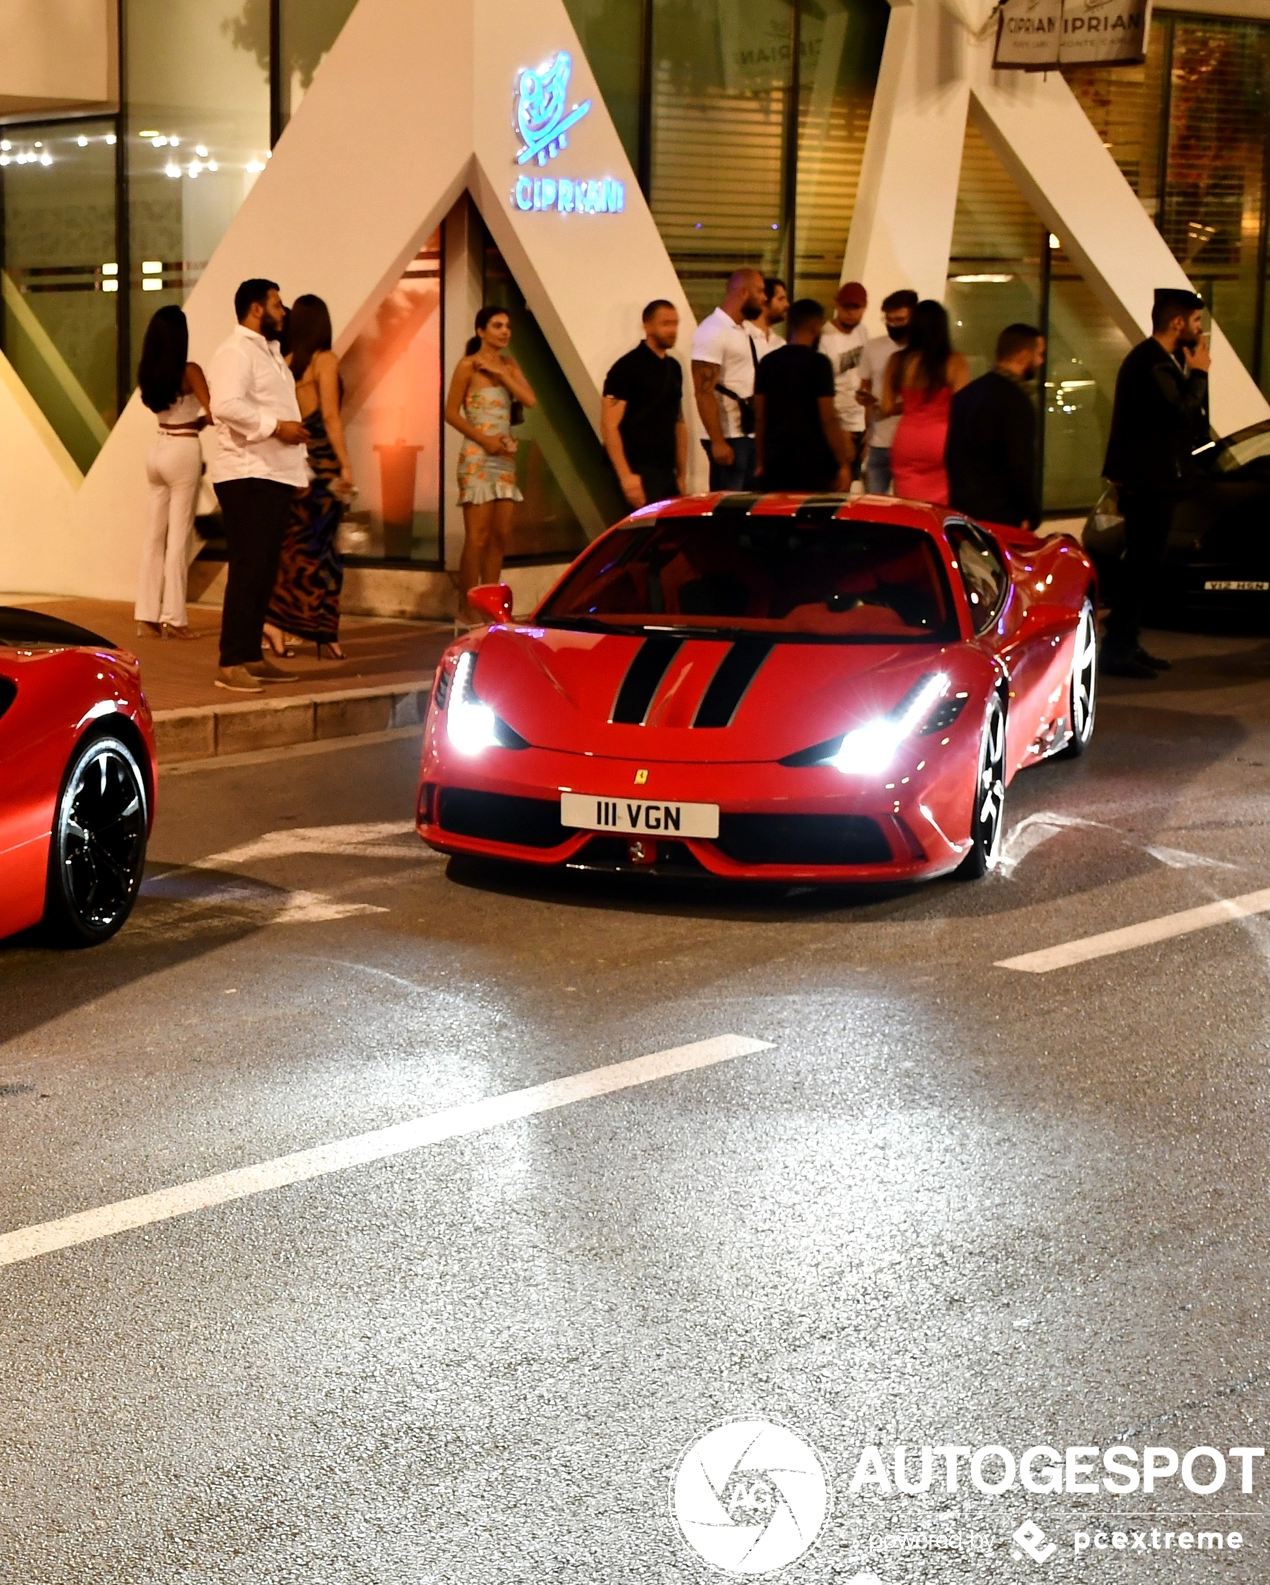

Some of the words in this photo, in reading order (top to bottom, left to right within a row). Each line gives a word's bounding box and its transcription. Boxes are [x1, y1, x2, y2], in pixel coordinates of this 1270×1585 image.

[1063, 13, 1142, 34] IPRIAN
[515, 177, 625, 212] CIPRIANI
[627, 803, 680, 831] VGN
